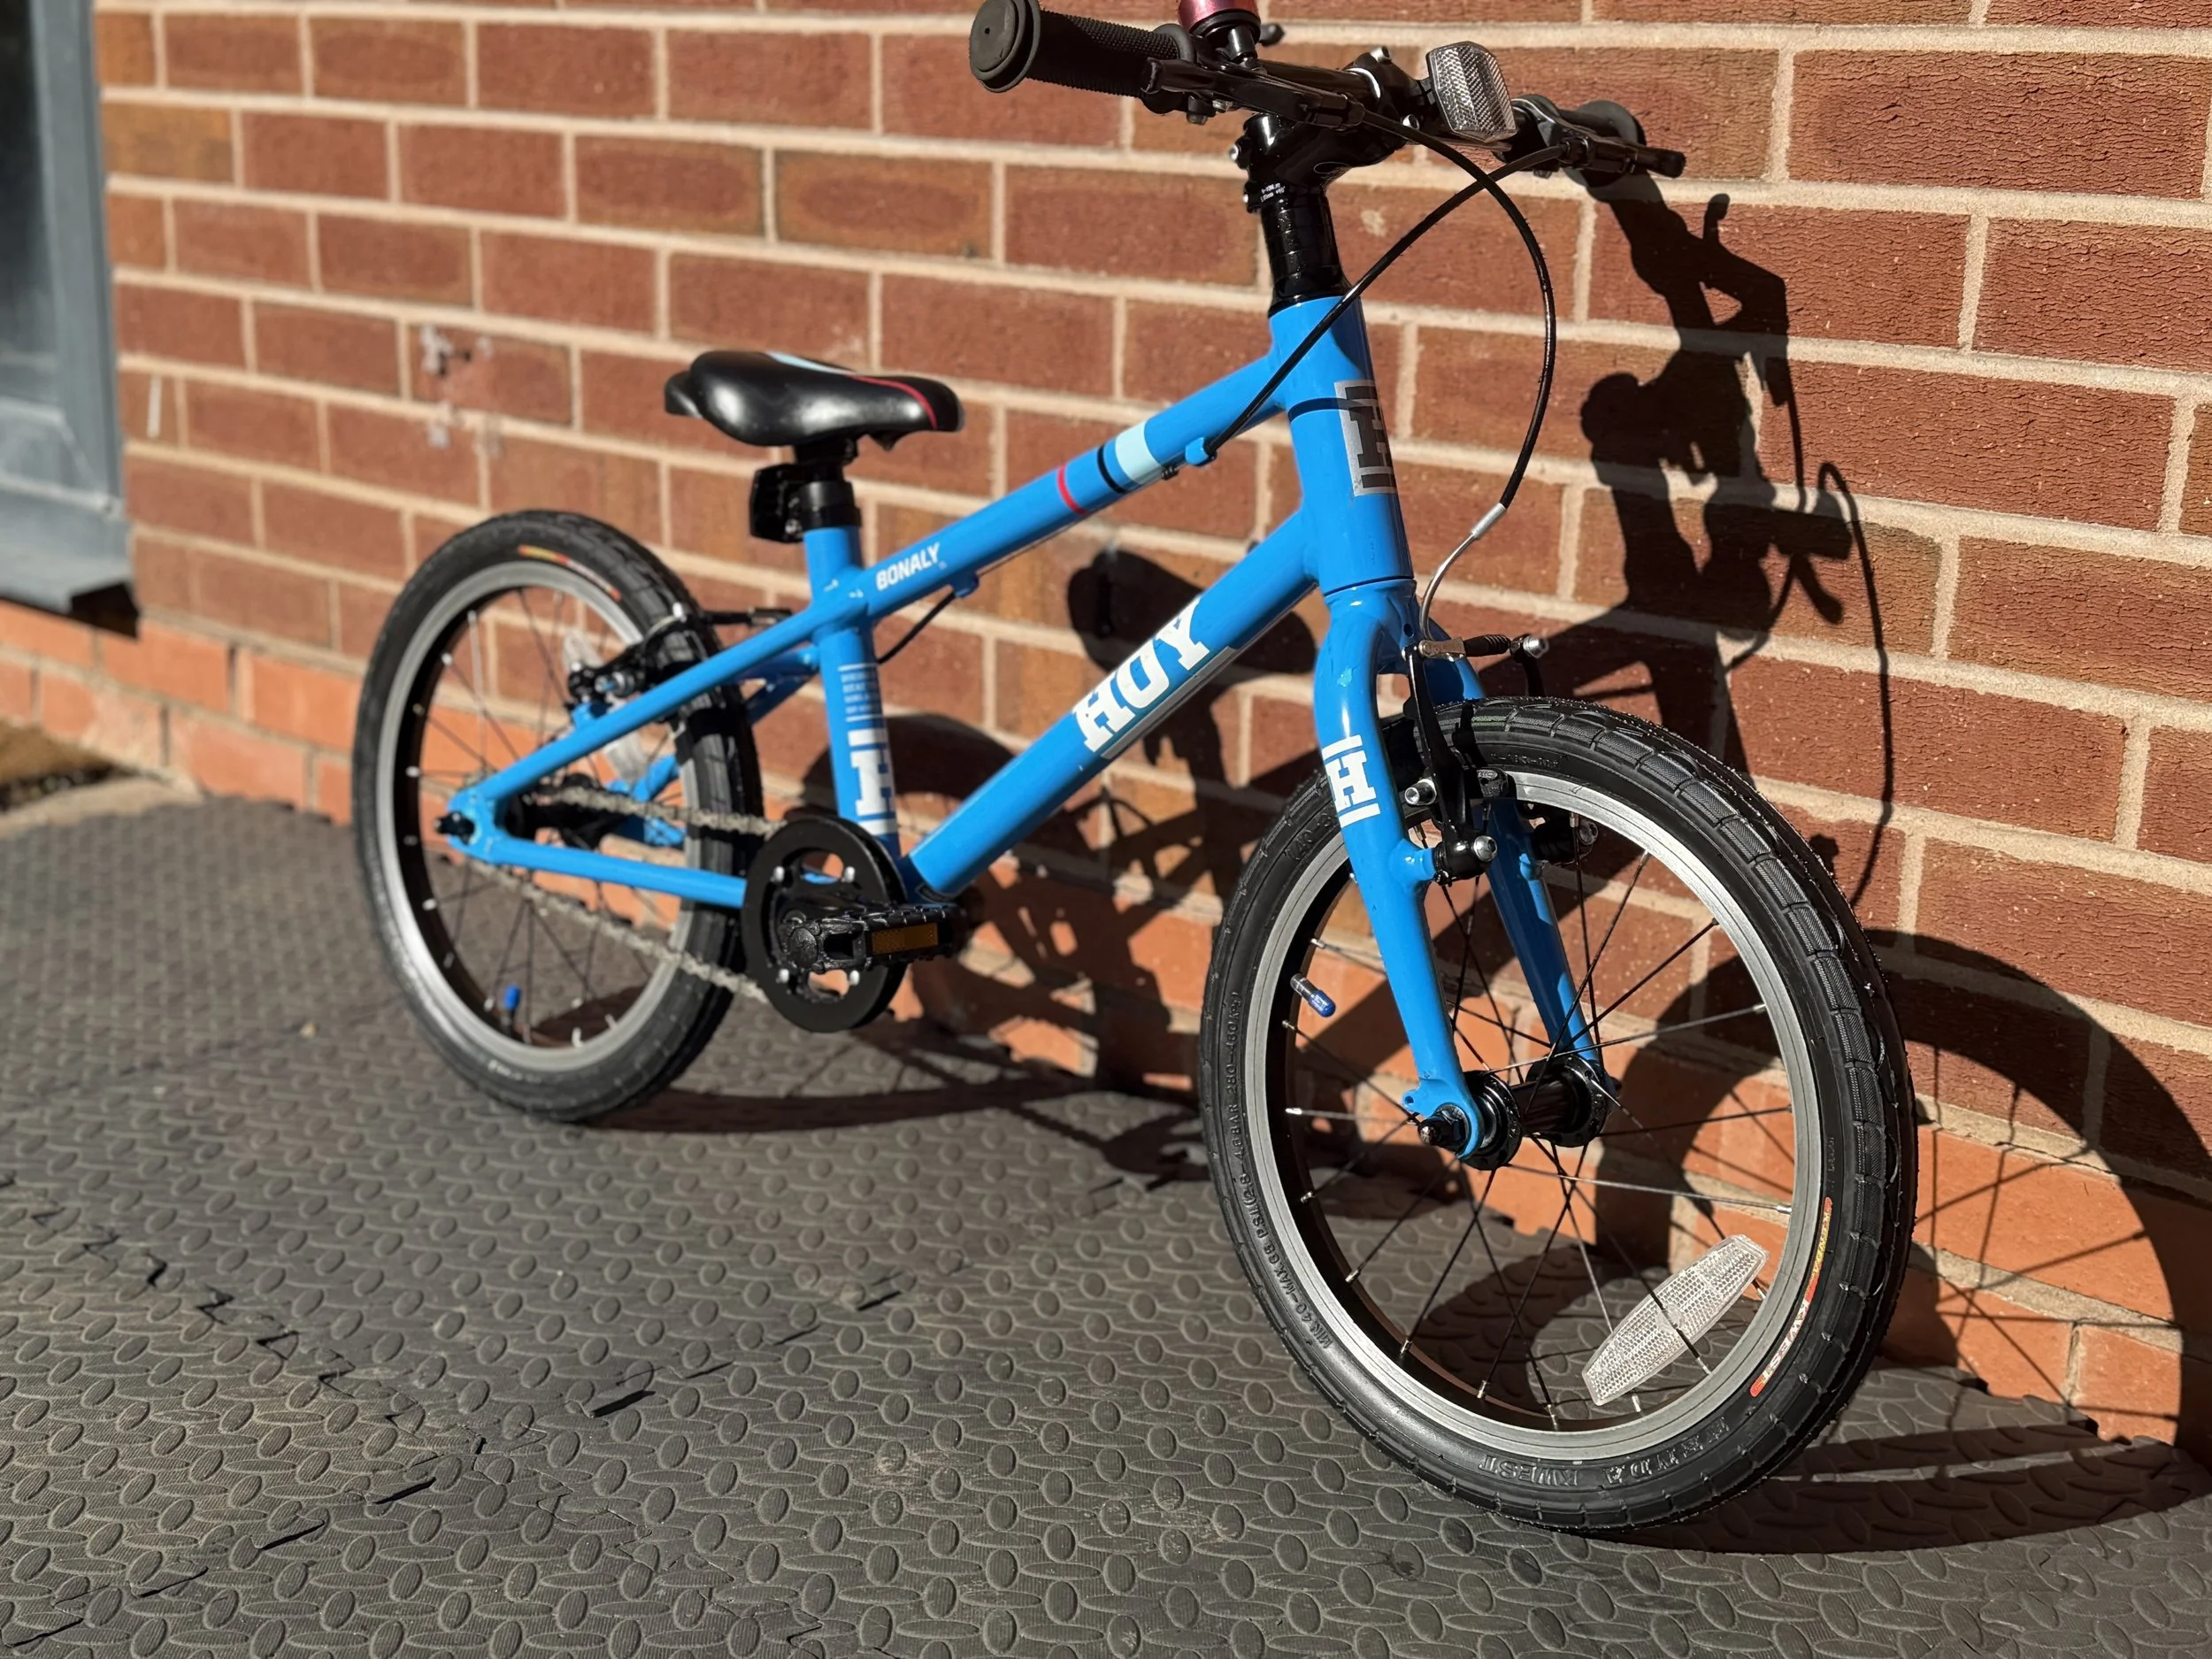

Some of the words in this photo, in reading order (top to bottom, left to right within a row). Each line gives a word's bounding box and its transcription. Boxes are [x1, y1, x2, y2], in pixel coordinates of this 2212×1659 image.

[875, 541, 941, 592] BONALY
[1071, 594, 1210, 752] HOY
[1325, 750, 1377, 813] H
[1761, 1301, 1812, 1385] KWEST
[1478, 1454, 1579, 1487] KWEST
